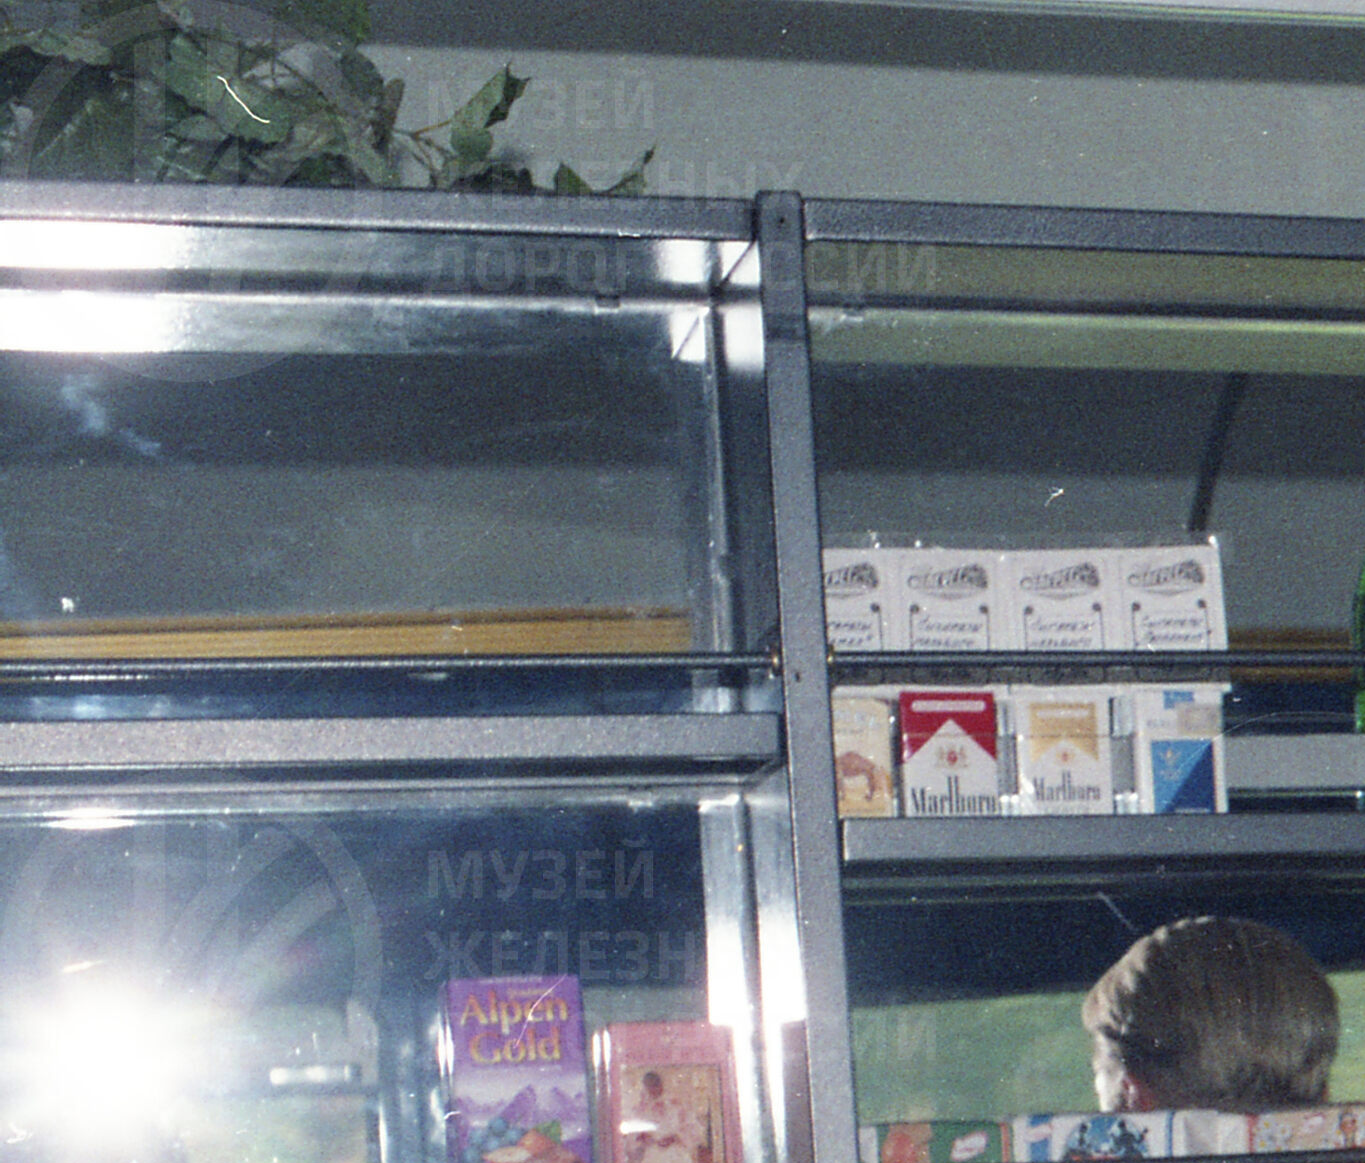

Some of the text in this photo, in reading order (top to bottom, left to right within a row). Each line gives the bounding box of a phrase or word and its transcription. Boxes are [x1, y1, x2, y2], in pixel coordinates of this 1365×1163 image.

[910, 777, 998, 814] Marlboro
[1032, 771, 1102, 803] Marlboro
[460, 990, 569, 1035] Alpen
[469, 1026, 563, 1065] Gold
